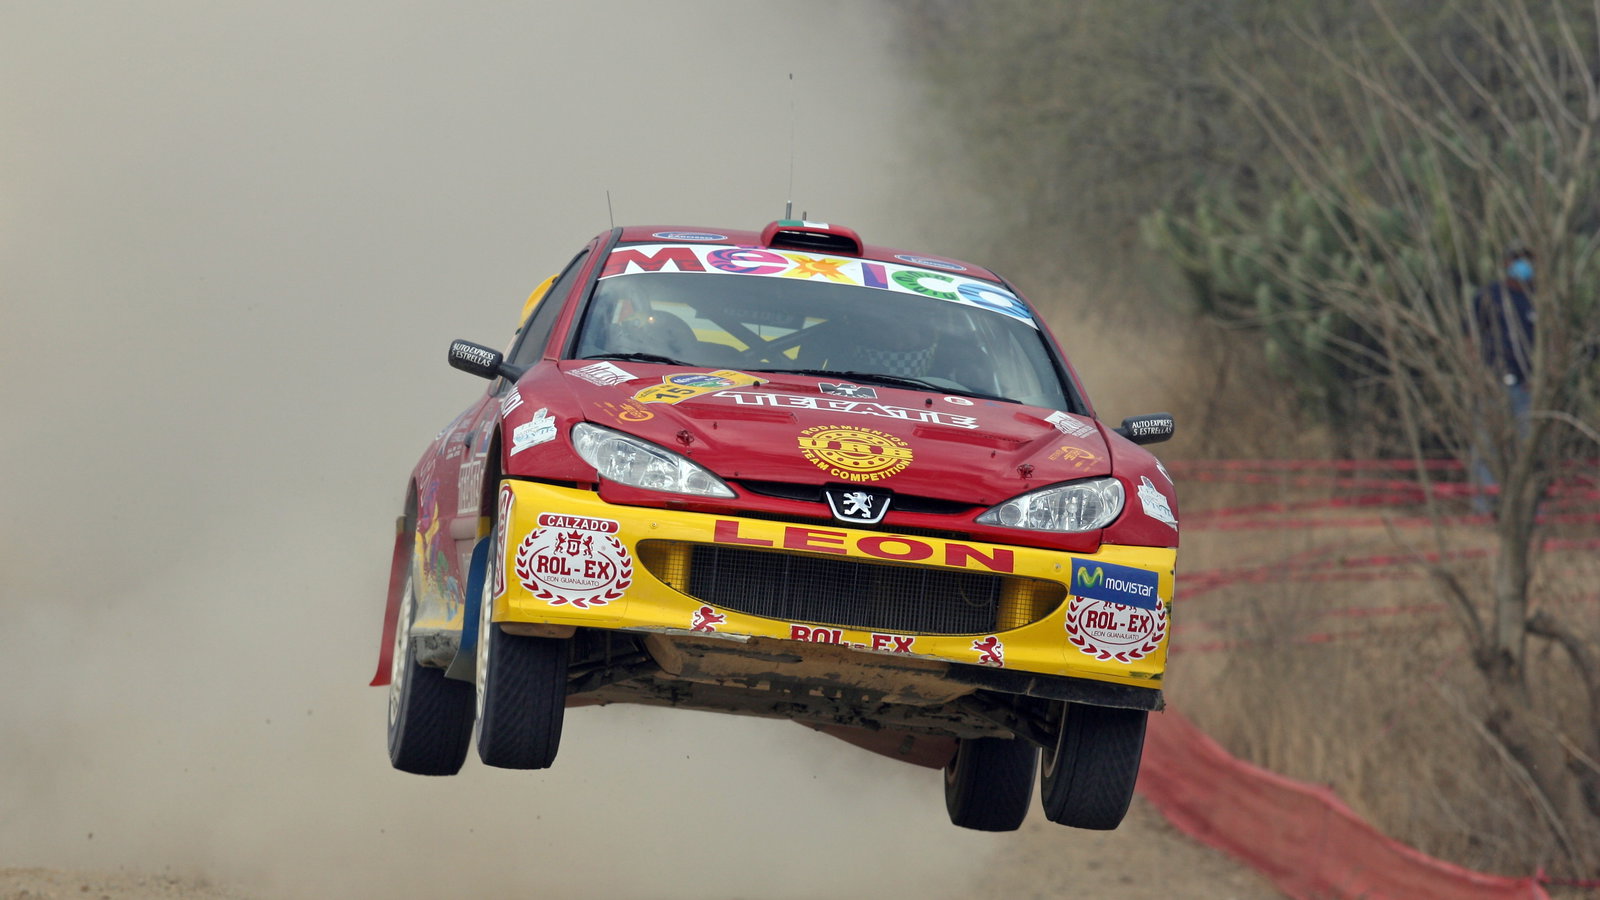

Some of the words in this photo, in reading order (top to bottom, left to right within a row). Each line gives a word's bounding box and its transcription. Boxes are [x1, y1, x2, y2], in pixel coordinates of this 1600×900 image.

[453, 343, 471, 353] AUTO
[470, 347, 496, 360] EXPRESS
[456, 350, 492, 367] ESTRELLAS
[656, 387, 695, 399] 15
[713, 391, 979, 429] TECATE
[1132, 420, 1150, 429] AUTO
[1150, 419, 1173, 428] EXPRESS
[1140, 427, 1172, 436] ESTRELLAS
[801, 424, 909, 447] RODAMIENTOS
[801, 448, 830, 471] TEAM
[830, 458, 912, 482] COMPETITION
[547, 515, 610, 532] CALZADO
[561, 577, 600, 587] GUANAJUATO
[1105, 578, 1154, 597] movistar
[1107, 632, 1140, 640] GUANAJUATO
